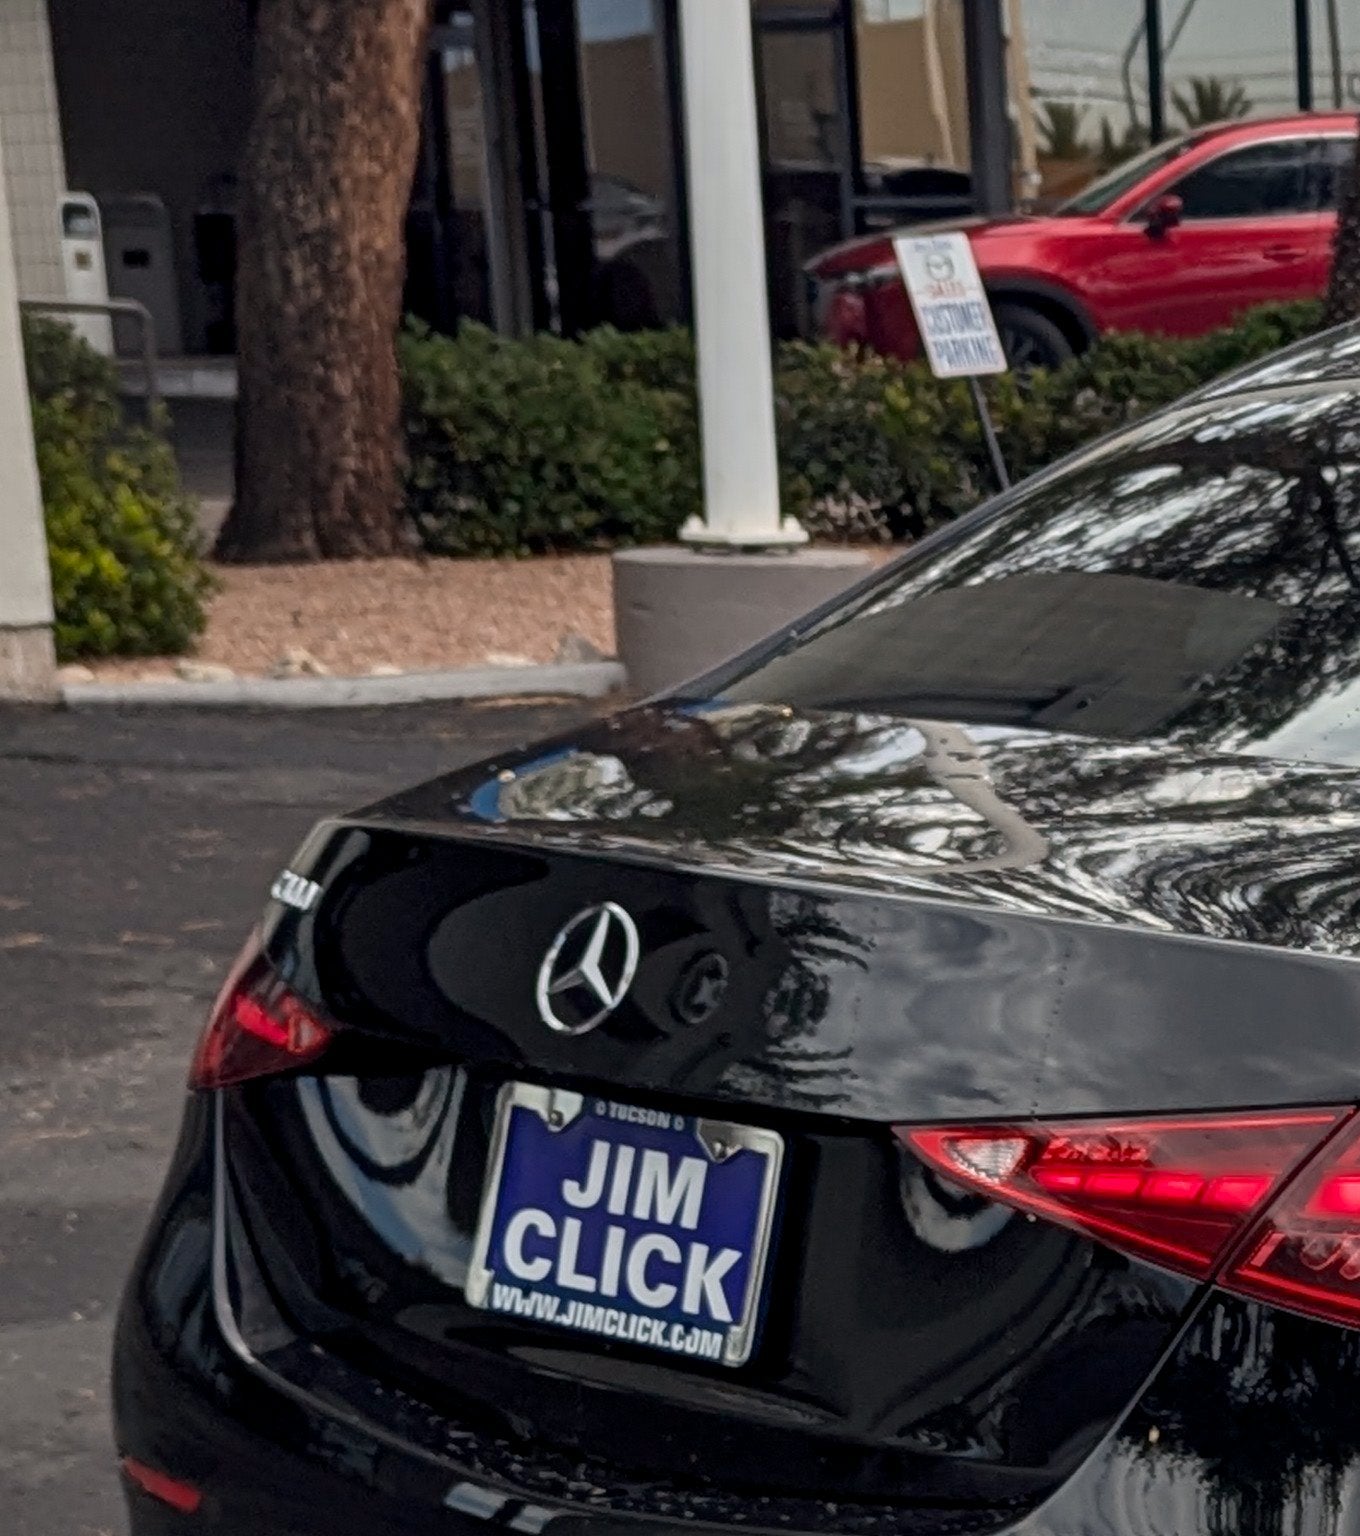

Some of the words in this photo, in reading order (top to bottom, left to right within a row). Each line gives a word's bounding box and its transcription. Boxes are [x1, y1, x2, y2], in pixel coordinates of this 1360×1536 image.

[932, 336, 997, 367] PARKING
[608, 1100, 671, 1128] TUCSON
[562, 1138, 708, 1230] JIM
[503, 1207, 743, 1323] CLICK
[491, 1283, 724, 1359] WWW.JIMCLICK.COM
